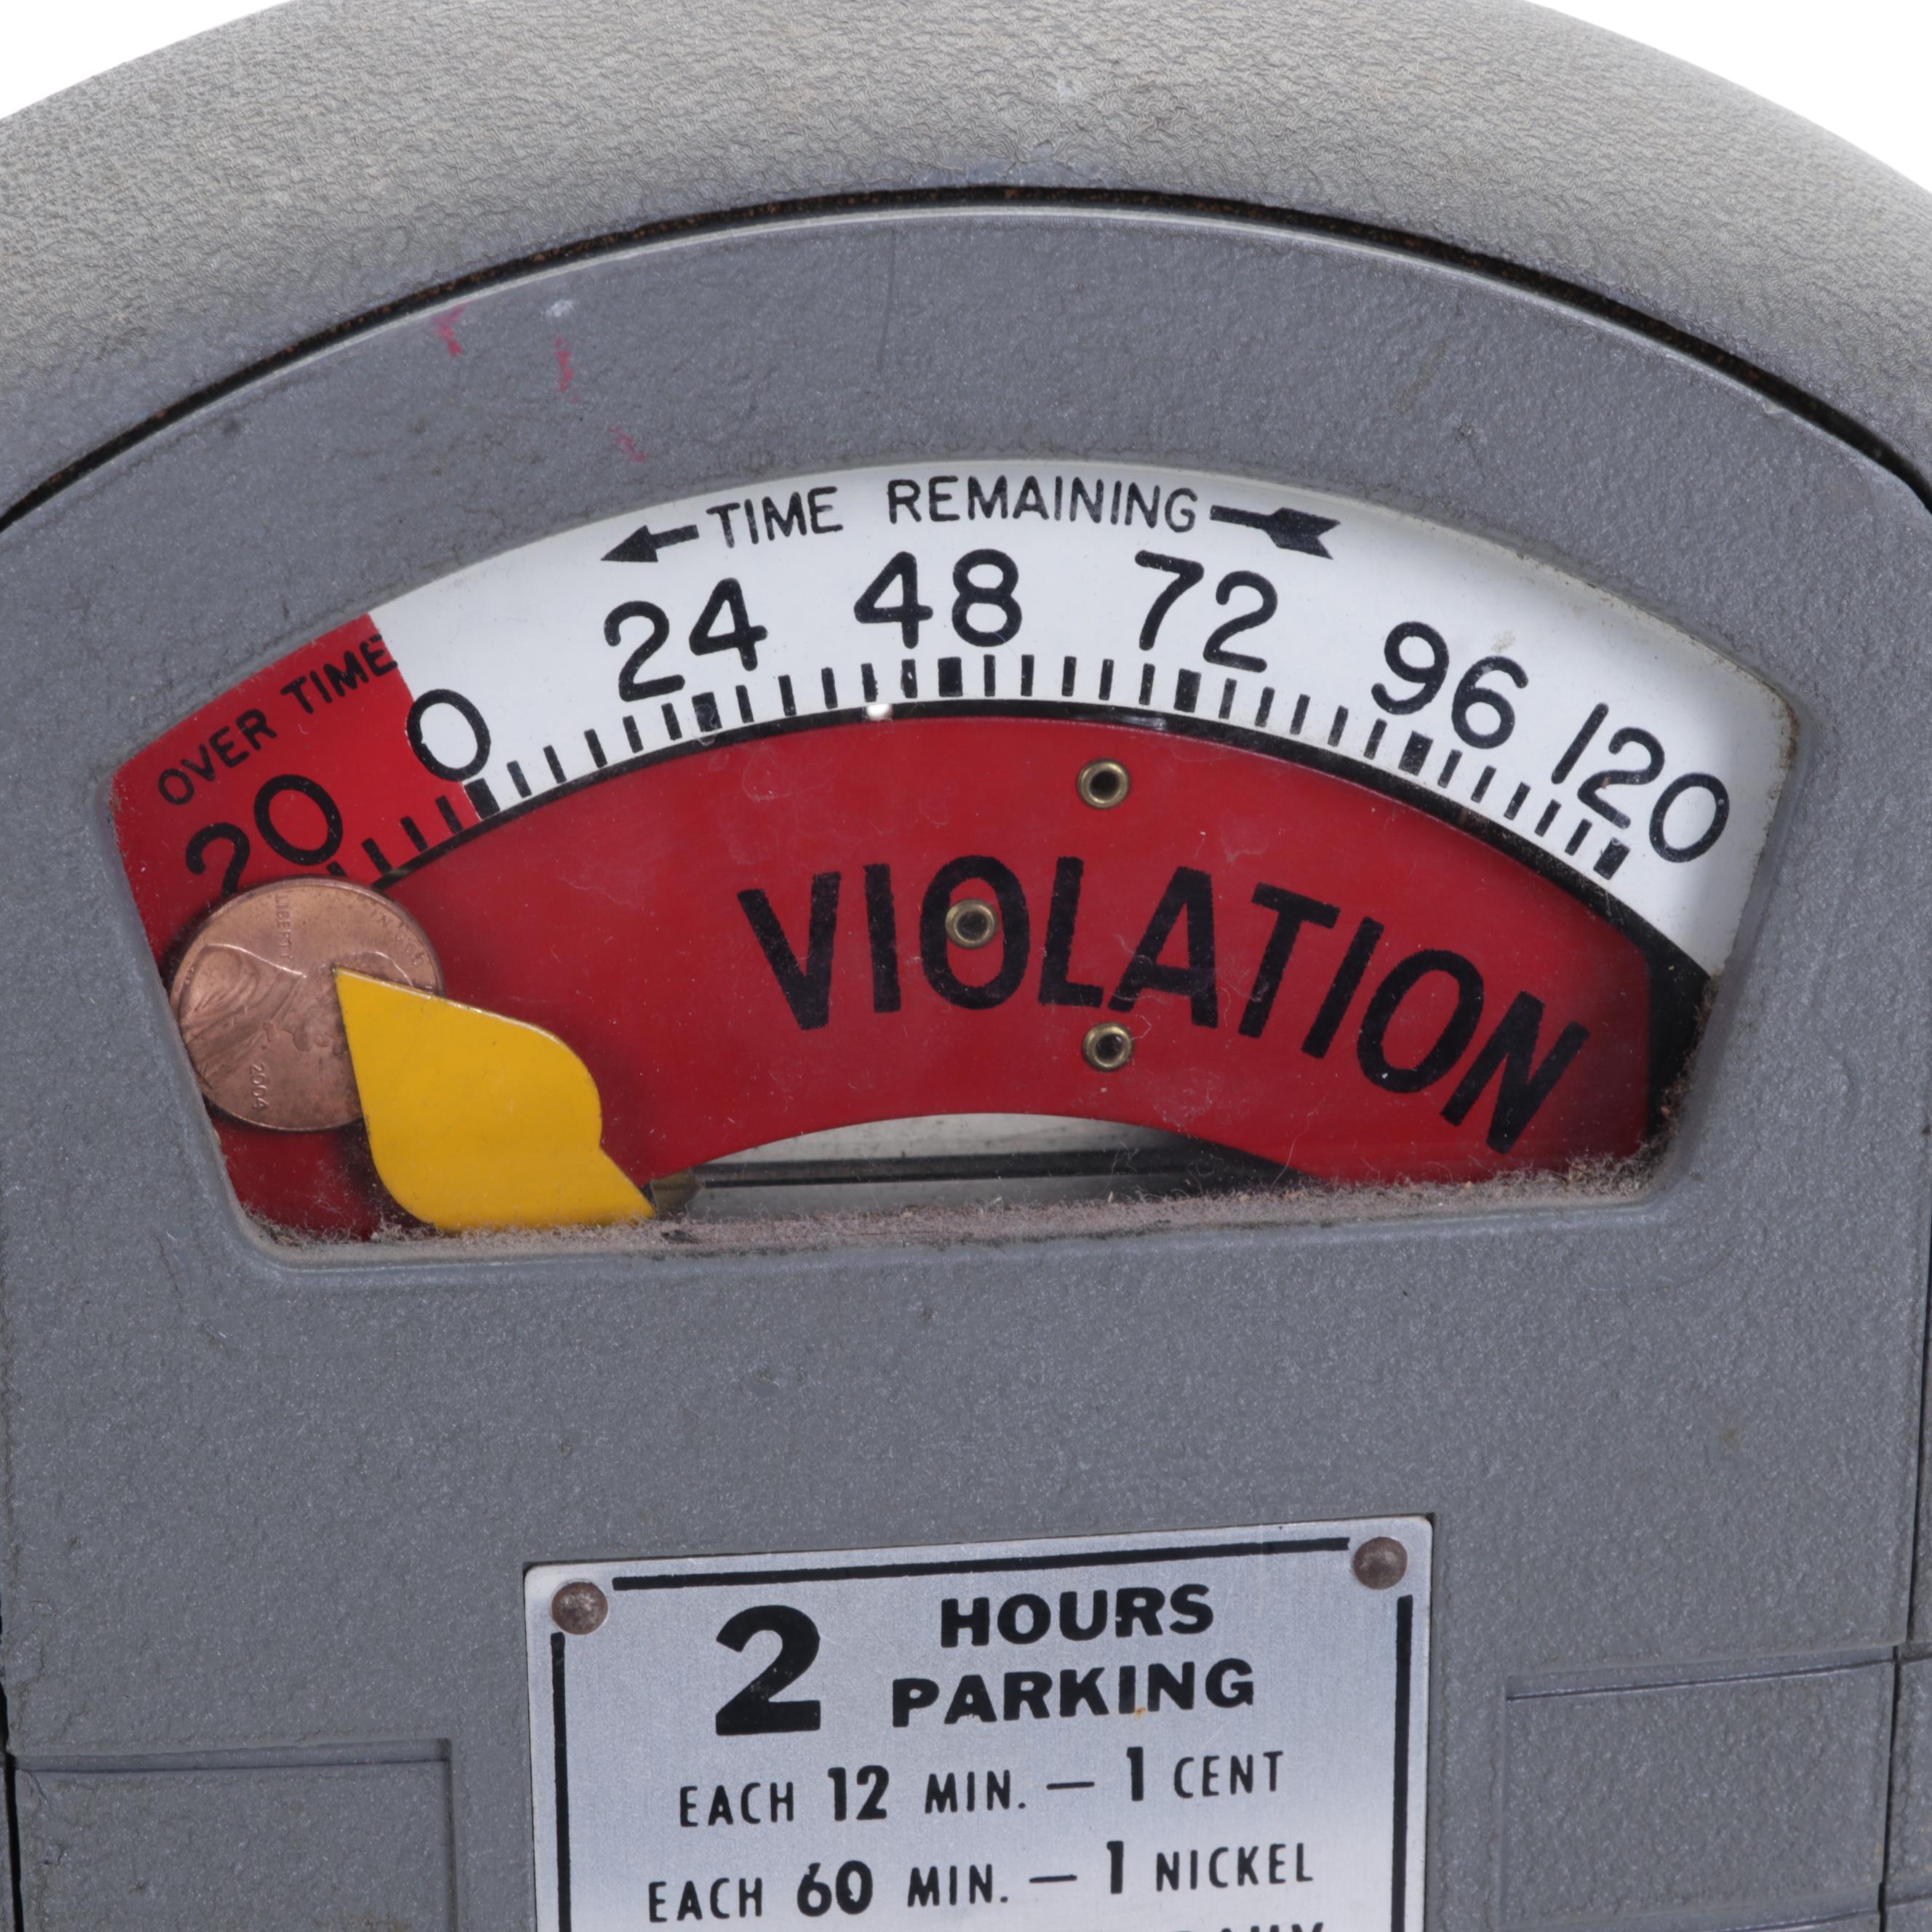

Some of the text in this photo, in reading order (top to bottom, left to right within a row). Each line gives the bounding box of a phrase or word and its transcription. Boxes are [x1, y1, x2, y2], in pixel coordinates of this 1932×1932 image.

[705, 475, 1198, 548] TIME REMAINING
[158, 634, 398, 805] OVER TIME
[406, 688, 491, 782] 0
[604, 578, 767, 702] 24
[853, 548, 1023, 649] 48
[1135, 550, 1277, 673] 72
[1371, 621, 1528, 749] 96
[1551, 703, 1730, 863] 120
[737, 854, 1591, 1155] VIOLATION
[250, 1061, 270, 1112] 2004
[715, 1584, 1214, 1736] 2 HOURS
[892, 1658, 1254, 1728] PARKING
[679, 1781, 794, 1827] EACH
[827, 1765, 890, 1821] 12
[925, 1769, 1026, 1814] MIN.
[1126, 1746, 1144, 1802] 1
[1173, 1751, 1283, 1799] CENT
[648, 1877, 762, 1923] EACH
[797, 1860, 873, 1917] 60
[907, 1864, 1008, 1907] MIN.
[1106, 1840, 1124, 1894] 1
[1156, 1843, 1312, 1891] NICKEL
